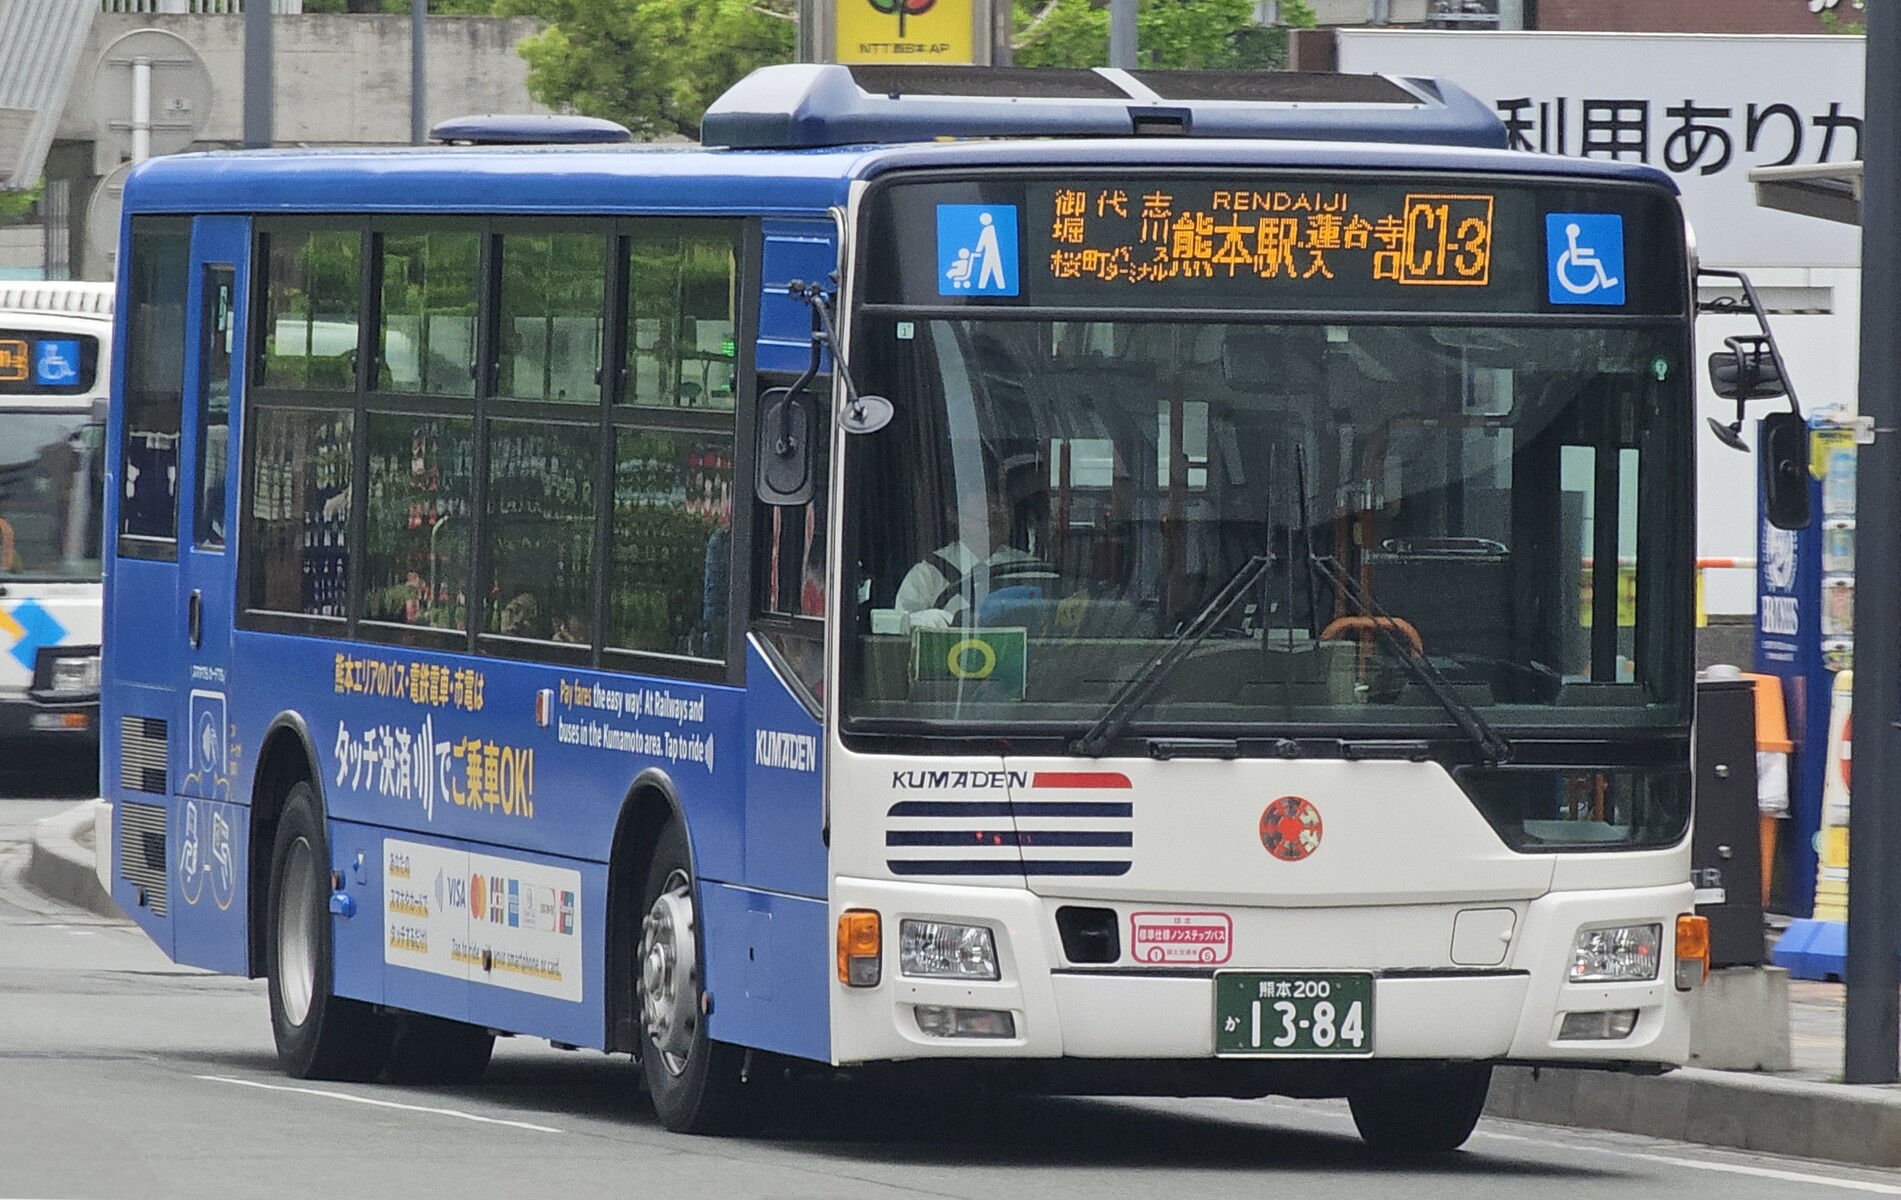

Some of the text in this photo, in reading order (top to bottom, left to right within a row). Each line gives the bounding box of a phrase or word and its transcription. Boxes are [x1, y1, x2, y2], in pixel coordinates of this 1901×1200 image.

[1213, 191, 1347, 211] RENDAIJI
[1409, 203, 1486, 277] C1-3
[560, 679, 573, 711] Pay
[593, 682, 606, 710] the
[606, 689, 624, 719] easy
[625, 687, 643, 720] way!
[644, 689, 654, 716] At
[655, 689, 688, 727] Railways
[688, 694, 704, 722] and
[559, 715, 704, 765] buses in the Kumamoto area. Tap to ride
[755, 729, 816, 772] KUMADEN
[892, 771, 1027, 789] KUMADEN
[447, 876, 466, 909] VISA
[1204, 952, 1211, 960] 5
[1259, 980, 1331, 999] 熊本200
[1225, 1001, 1364, 1048] か 13-84
